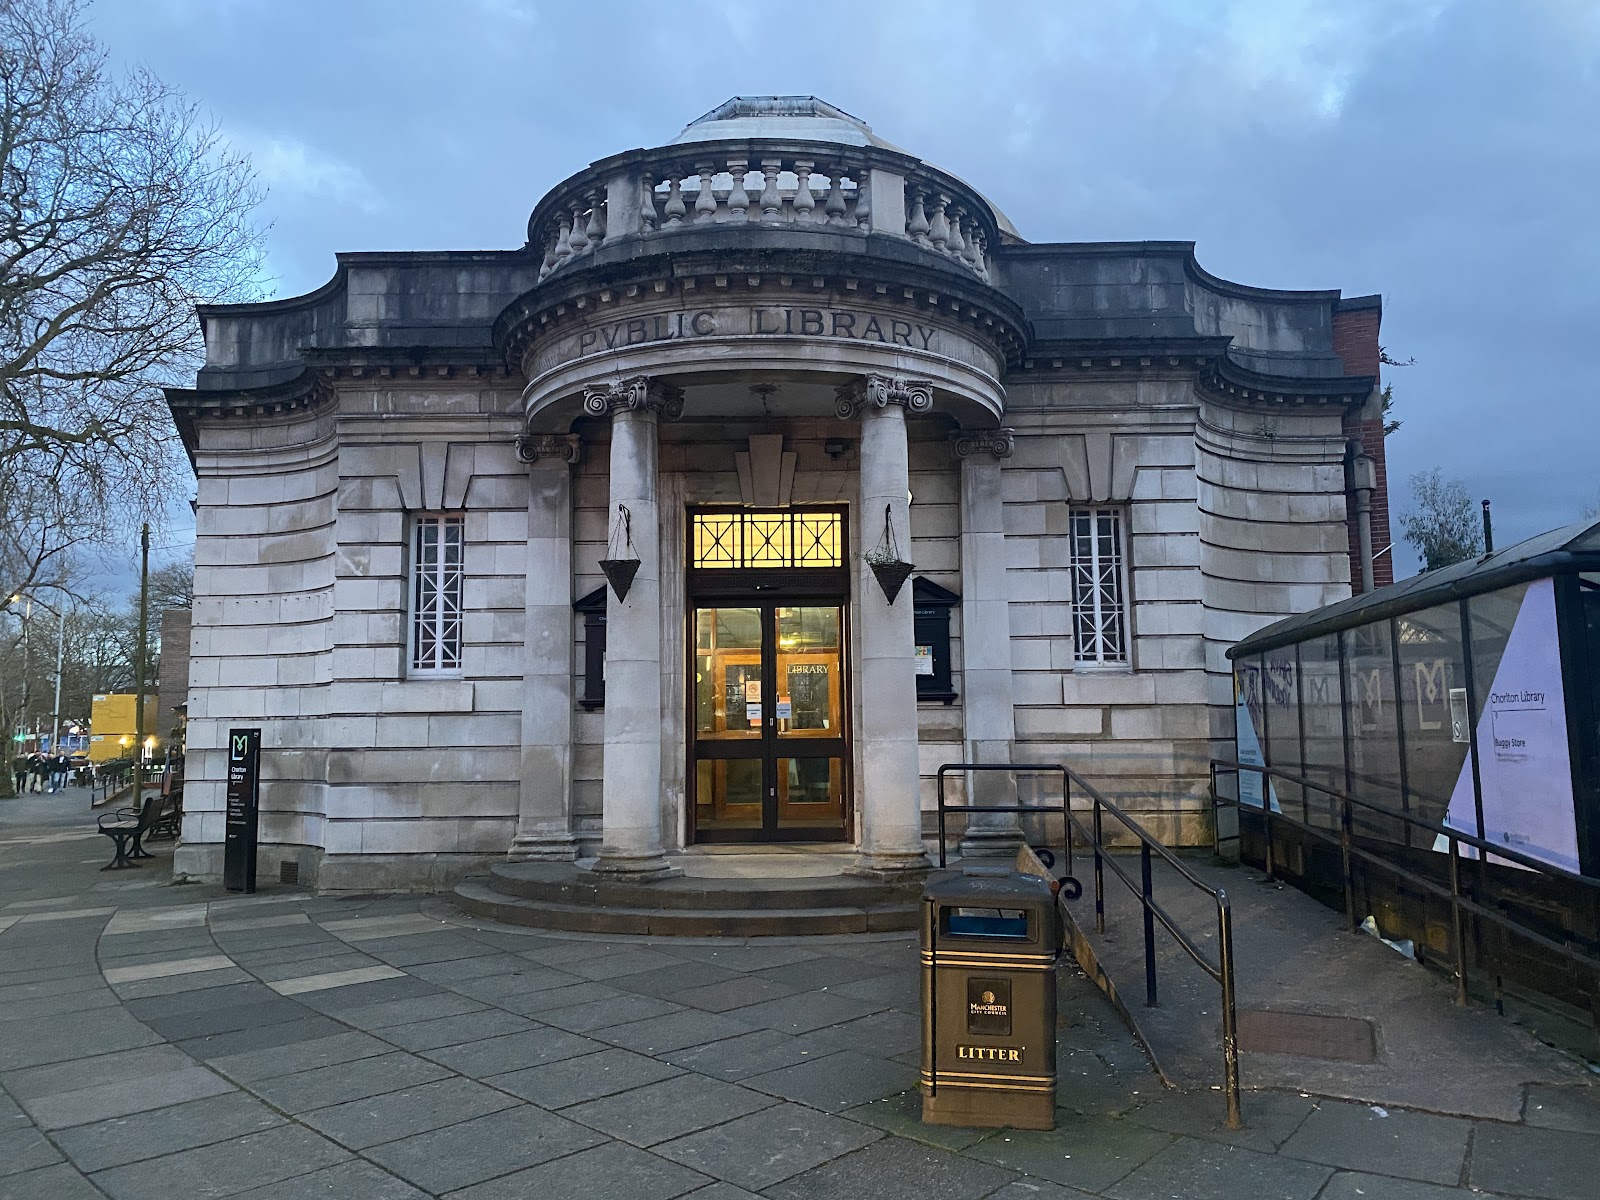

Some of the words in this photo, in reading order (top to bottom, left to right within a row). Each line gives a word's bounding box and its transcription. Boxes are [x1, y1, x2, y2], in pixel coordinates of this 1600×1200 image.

[579, 310, 715, 357] PVBLIC
[754, 309, 936, 350] LIBRARY
[787, 665, 829, 674] LIBRARY
[1491, 692, 1520, 704] Chorlton
[1520, 690, 1545, 705] Library
[1511, 738, 1526, 748] Store
[958, 1046, 1020, 1062] LITTER
